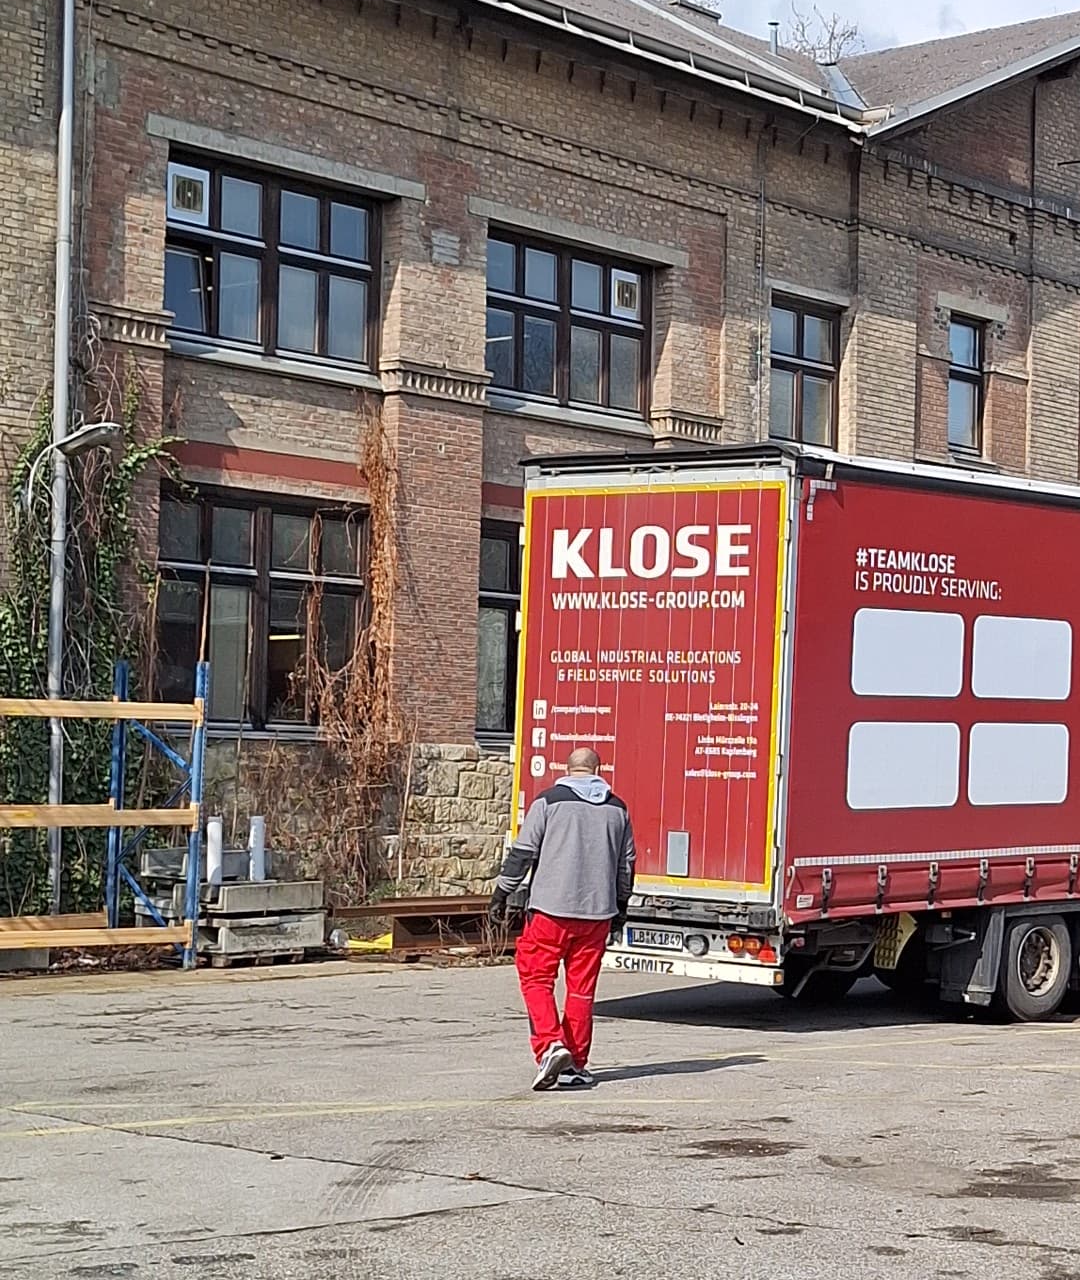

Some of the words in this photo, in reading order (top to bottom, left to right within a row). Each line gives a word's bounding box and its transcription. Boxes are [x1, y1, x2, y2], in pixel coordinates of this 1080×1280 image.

[552, 524, 751, 579] KLOSE
[856, 548, 956, 574] #TEAMKLOSE
[855, 571, 869, 590] IS
[873, 572, 938, 596] PROUDLY
[941, 577, 1002, 601] SERVING:
[552, 590, 744, 610] WWW.KLOSE-GROUP.COM
[550, 650, 592, 663] GLOBAL
[597, 650, 664, 664] INDUSTRIAL
[666, 651, 741, 664] RELOCATIONS
[567, 669, 596, 681] FIELD
[599, 669, 642, 682] SERVICE
[649, 669, 716, 683] SOLUTIONS
[650, 932, 657, 945] K
[615, 956, 675, 974] SCHMITZ
